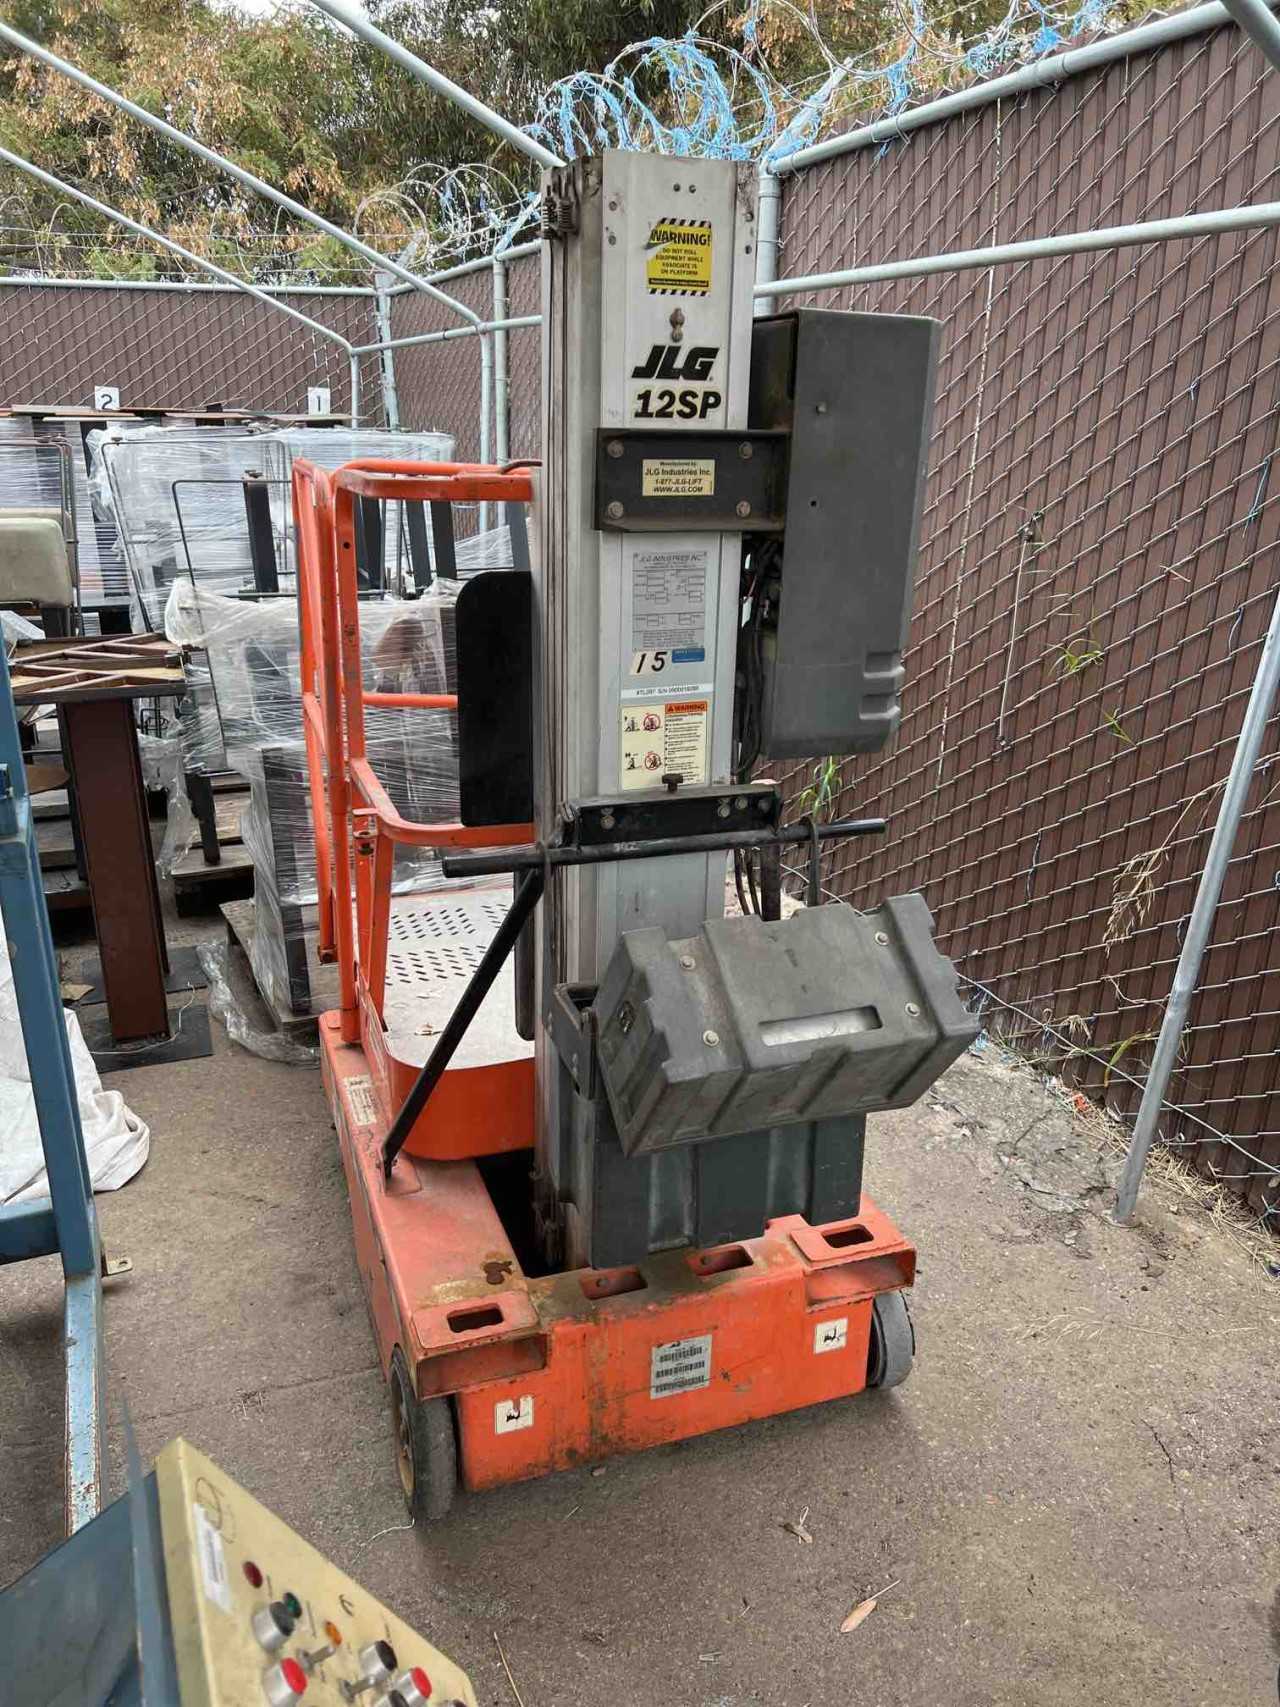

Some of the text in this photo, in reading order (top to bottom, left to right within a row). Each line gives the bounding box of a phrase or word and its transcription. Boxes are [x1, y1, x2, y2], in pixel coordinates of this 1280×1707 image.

[650, 230, 711, 246] WARNING!
[632, 345, 719, 380] JLG
[100, 393, 113, 410] 2
[316, 395, 321, 412] 1
[634, 390, 722, 419] 12SP
[645, 467, 660, 476] JLG
[661, 467, 698, 476] Industries
[674, 702, 705, 711] WARNING
